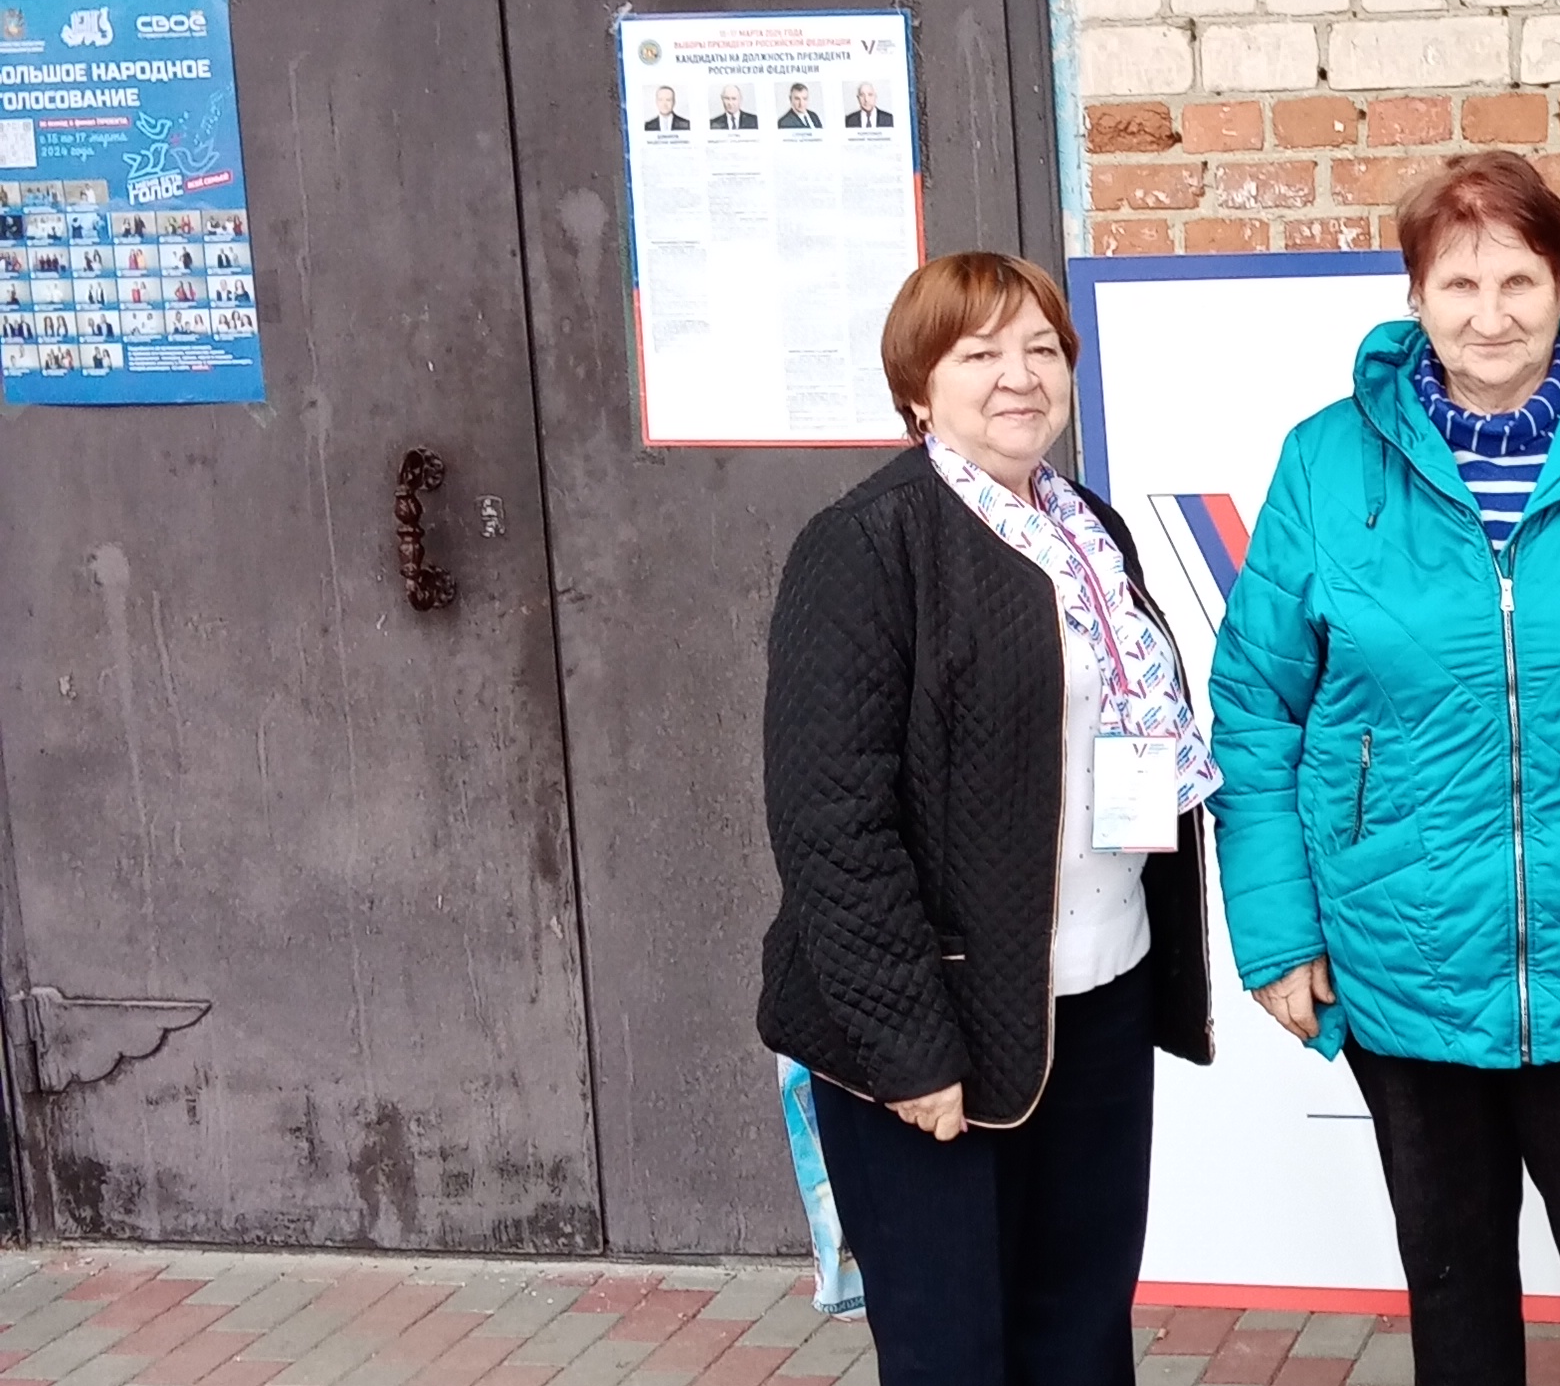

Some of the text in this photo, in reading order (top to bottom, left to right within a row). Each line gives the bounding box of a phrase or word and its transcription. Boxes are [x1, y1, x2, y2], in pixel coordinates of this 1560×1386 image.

[675, 51, 852, 64] КАНДИДАТЫ НА ДОЛЖНОСТЬ ПРЕЗИДЕНТА
[0, 59, 212, 85] ОЛЬШОЕ НАРОДНОЕ
[708, 64, 820, 75] РОССИЙСКОЙ ФЕДЕРАЦИИ
[0, 88, 140, 111] ОЛОСОВАНИЕ
[127, 180, 184, 205] ГОЛОС
